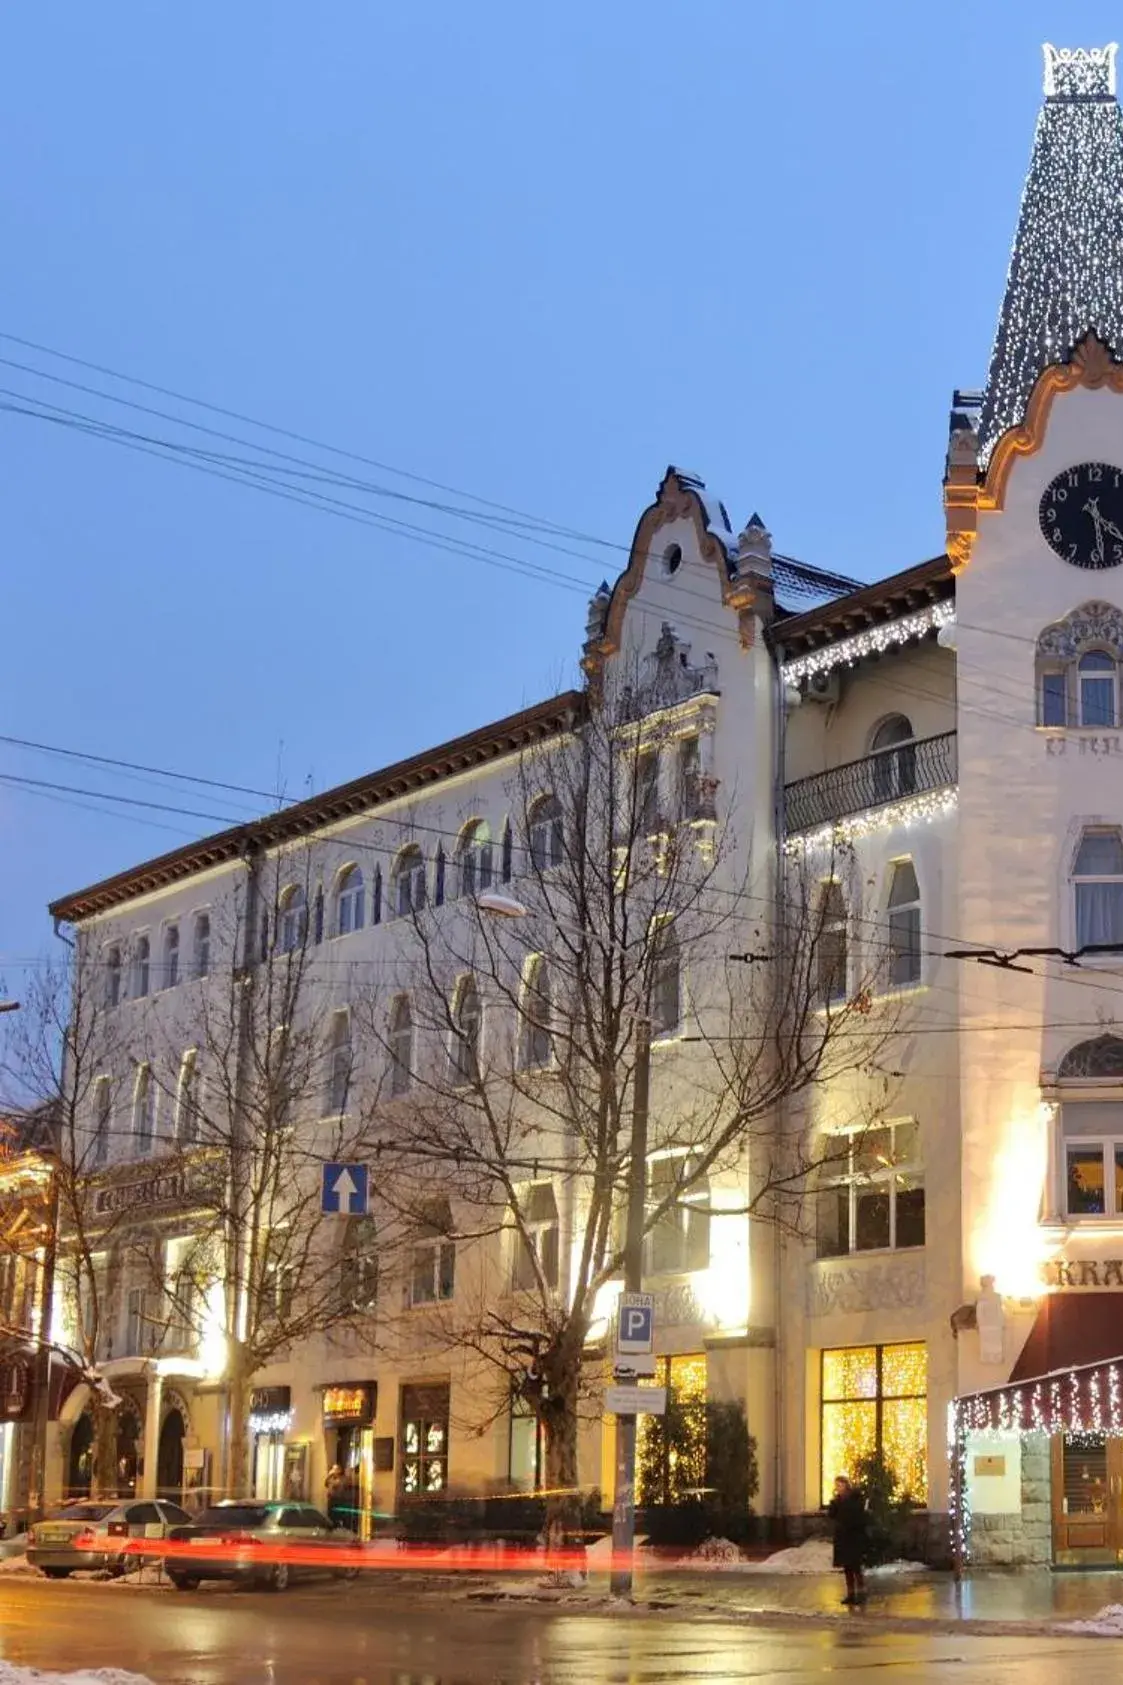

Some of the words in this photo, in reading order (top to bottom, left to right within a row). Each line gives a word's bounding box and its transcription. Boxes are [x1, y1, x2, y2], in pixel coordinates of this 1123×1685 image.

[1068, 474, 1079, 487] 11
[1088, 468, 1103, 482] 12
[1051, 488, 1068, 502] 10
[1046, 508, 1057, 522] 9
[1052, 527, 1063, 542] 8
[1068, 543, 1078, 557] 7
[1090, 548, 1100, 562] 6
[1112, 544, 1123, 559] 5
[628, 1310, 644, 1337] P
